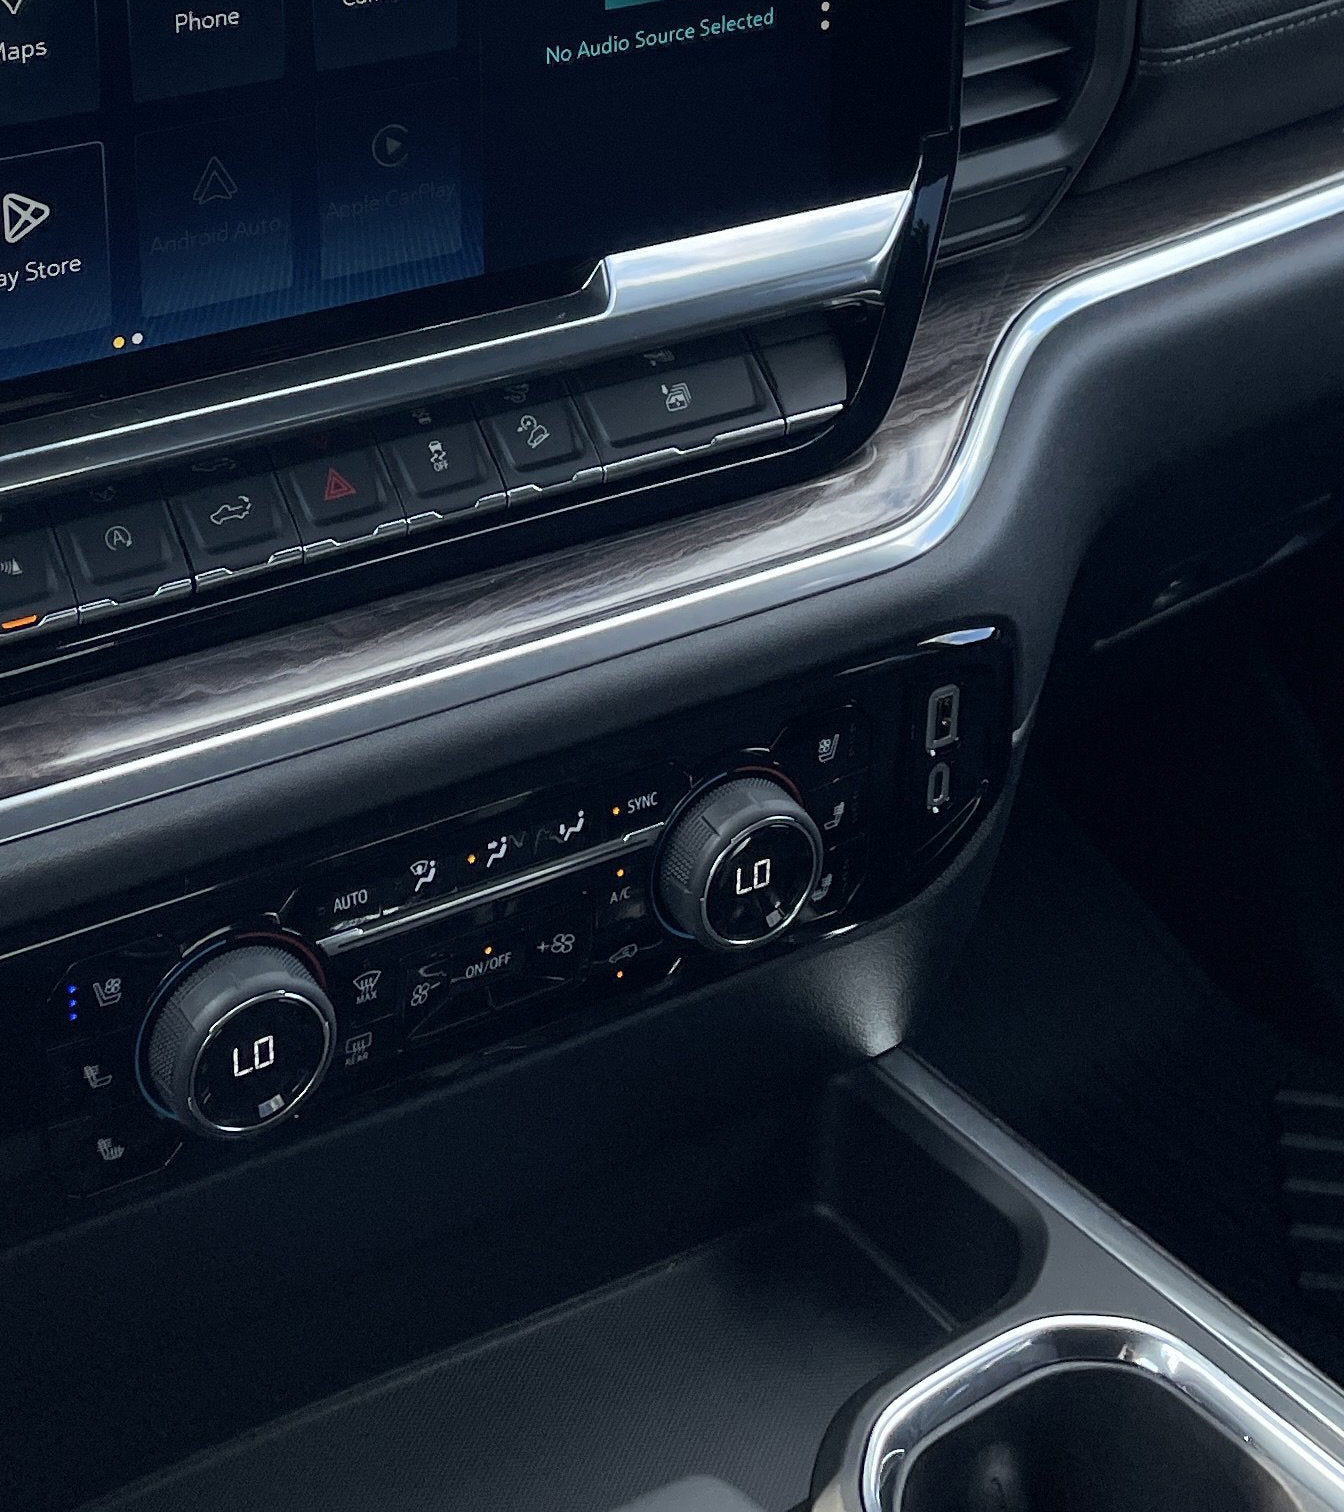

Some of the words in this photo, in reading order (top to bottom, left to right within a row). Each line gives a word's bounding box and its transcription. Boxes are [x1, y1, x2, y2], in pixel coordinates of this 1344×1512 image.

[174, 7, 240, 34] Phone
[546, 45, 574, 65] No
[577, 31, 630, 61] Audio
[635, 22, 695, 50] Source
[699, 7, 776, 38] Selected
[149, 222, 230, 255] Android
[234, 218, 282, 241] Auto
[24, 255, 82, 282] Store
[627, 792, 658, 814] SYNC
[333, 889, 368, 913] AUTO
[609, 887, 632, 905] A/C
[465, 952, 512, 979] ON/OFF
